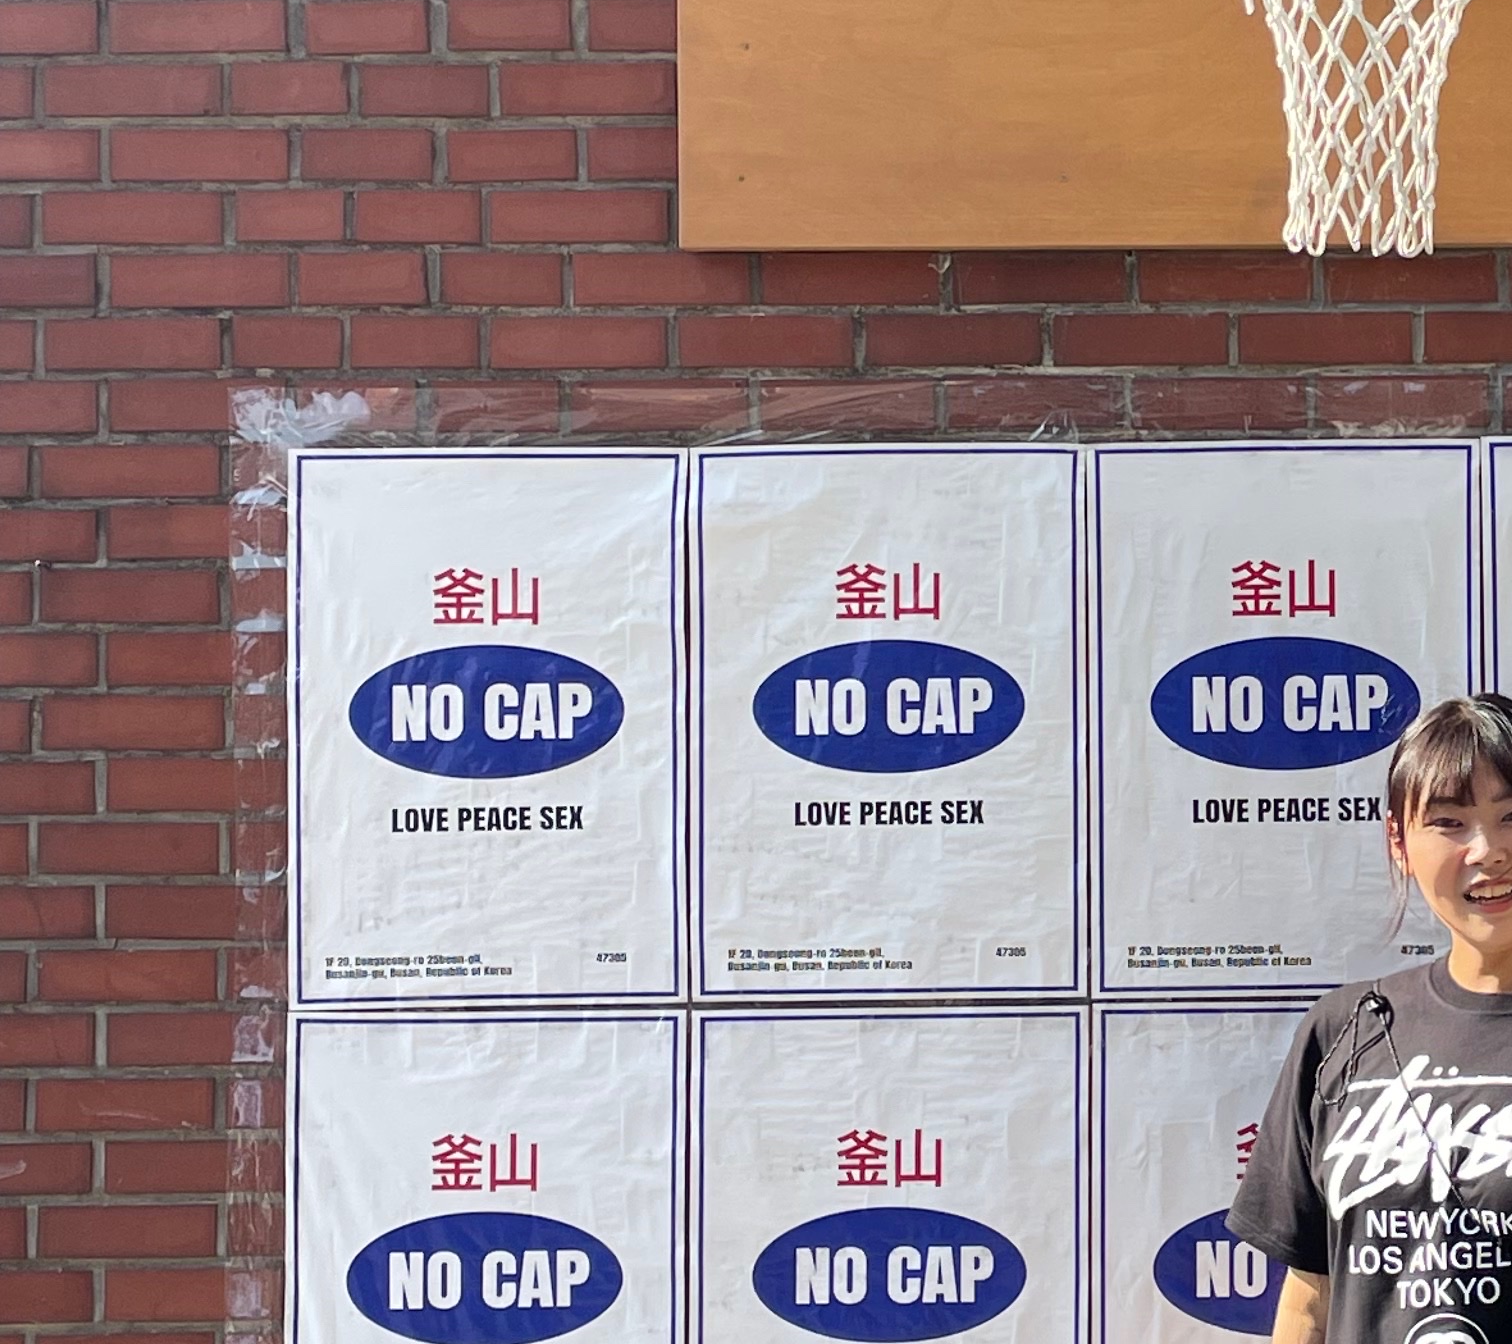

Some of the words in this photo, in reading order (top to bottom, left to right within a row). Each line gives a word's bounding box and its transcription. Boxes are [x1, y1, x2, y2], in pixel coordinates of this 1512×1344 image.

[435, 568, 540, 625] 釜山
[837, 563, 941, 620] 釜山
[1232, 559, 1336, 617] 釜山
[391, 683, 464, 742] NO
[484, 682, 593, 741] CAP
[795, 678, 867, 736] NO
[886, 677, 993, 735] CAP
[1192, 675, 1263, 733] NO
[1283, 674, 1389, 732] CAP
[392, 808, 449, 833] LOVE
[458, 806, 532, 832] PEACE
[540, 805, 583, 830] SEX
[794, 801, 851, 826] LOVE
[860, 800, 932, 825] PEACE
[940, 800, 984, 825] SEX
[1192, 798, 1249, 824] LOVE
[1257, 797, 1330, 823] PEACE
[1337, 796, 1382, 822] SEX
[885, 959, 912, 969] Korea
[434, 1134, 538, 1191] 釜山
[839, 1129, 943, 1186] 釜山
[388, 1250, 462, 1310] NO
[482, 1249, 590, 1309] CAP
[795, 1246, 868, 1305] NO
[887, 1245, 994, 1304] CAP
[1195, 1241, 1267, 1298] NO
[1349, 1244, 1403, 1274] LOS
[1396, 1276, 1501, 1309] TOKYO
